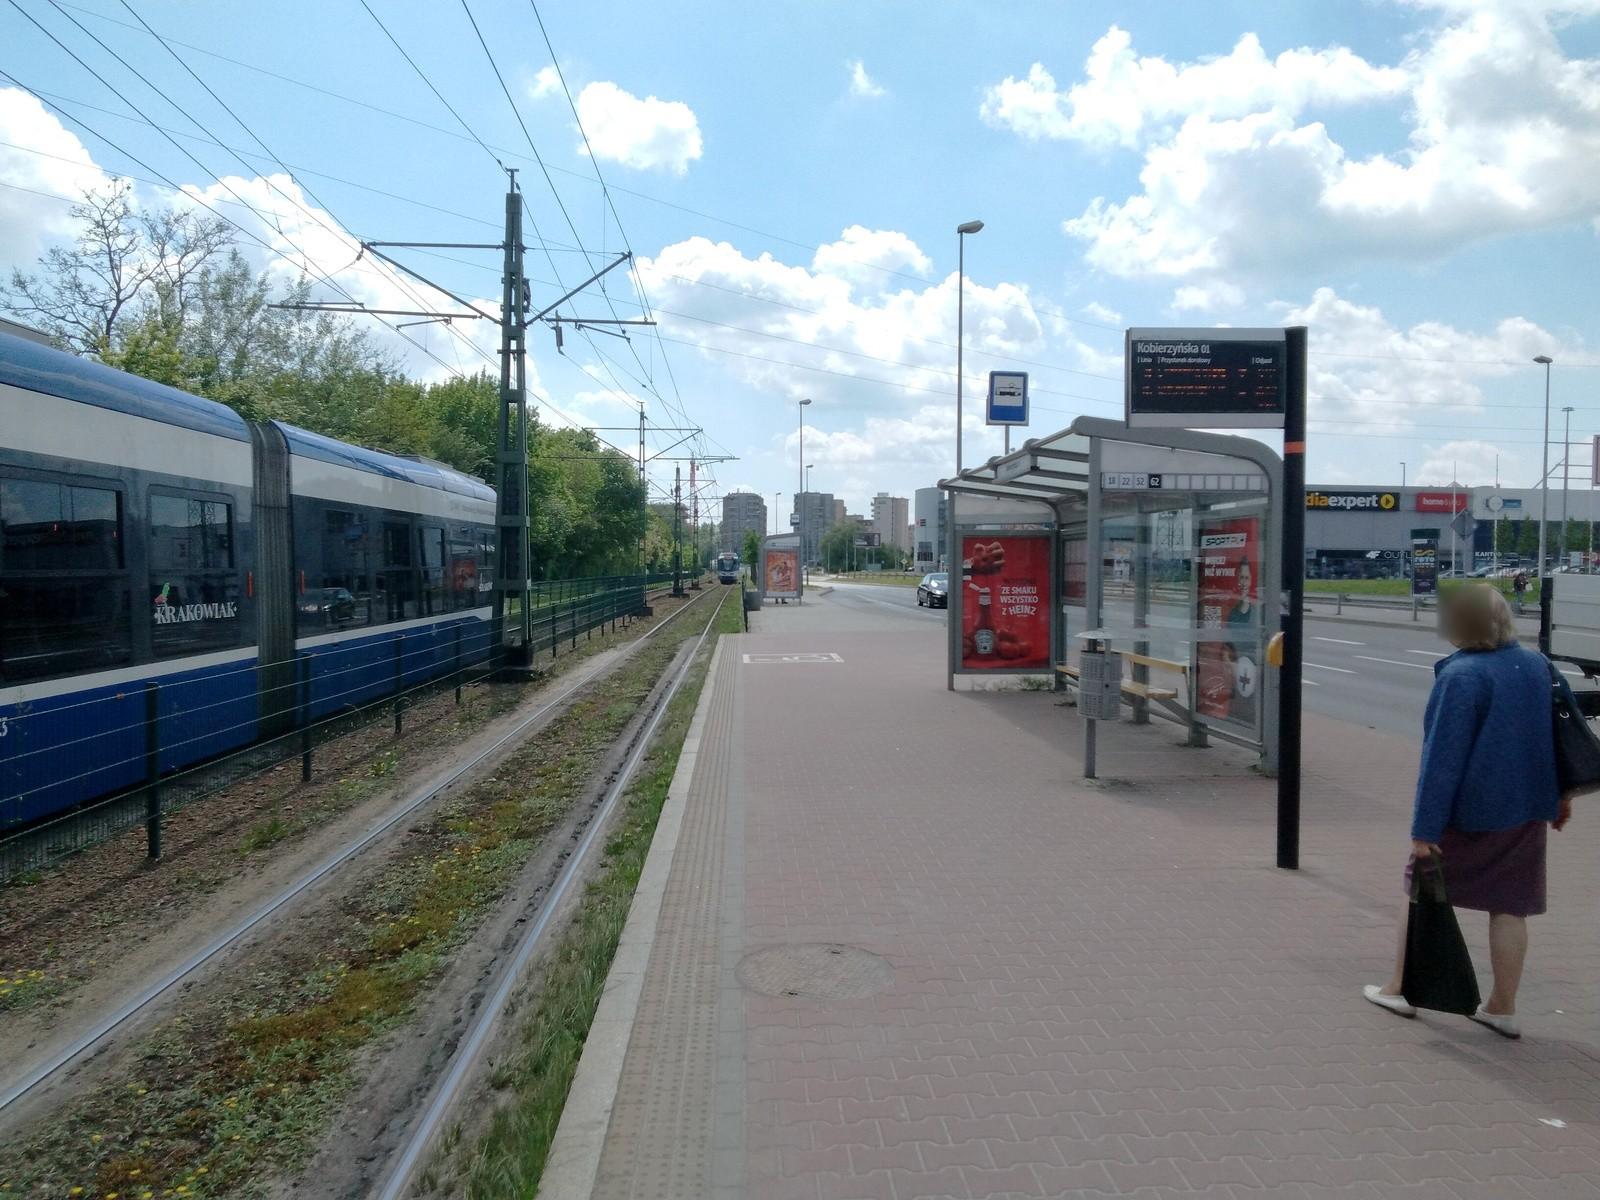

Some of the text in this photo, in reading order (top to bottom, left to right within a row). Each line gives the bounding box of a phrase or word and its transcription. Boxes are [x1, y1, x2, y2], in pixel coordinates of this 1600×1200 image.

[1138, 342, 1198, 355] Kobierzyńska
[1306, 492, 1378, 510] diaexpert
[1384, 551, 1412, 559] OUTL
[1001, 586, 1037, 594] ZE SMAKU
[1000, 595, 1039, 604] WSZYSTKO
[156, 601, 236, 625] KRAKOWIAK
[1002, 605, 1037, 616] Z HEINZ
